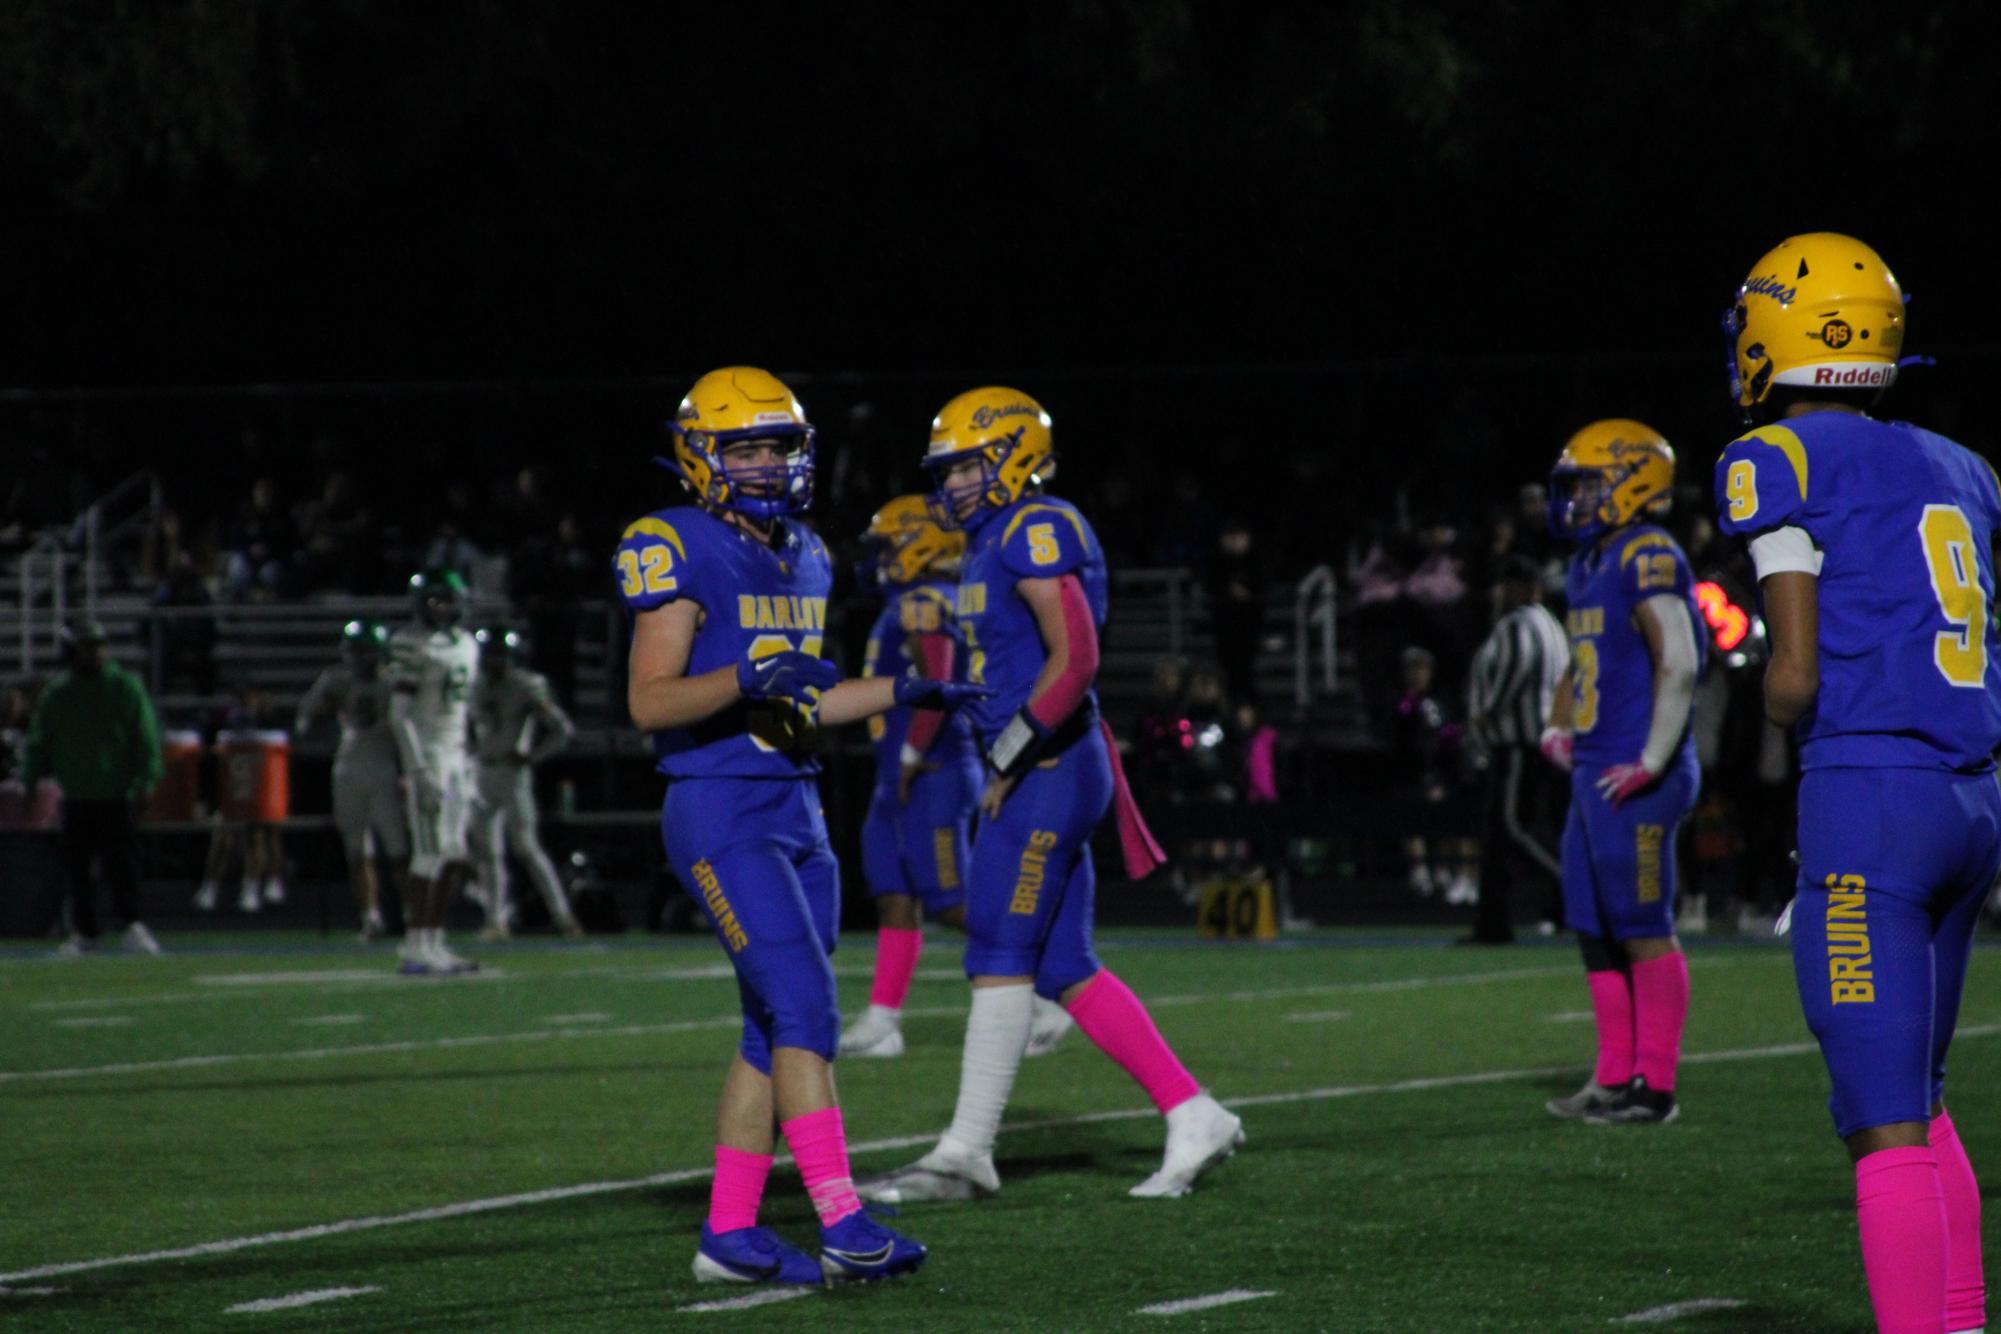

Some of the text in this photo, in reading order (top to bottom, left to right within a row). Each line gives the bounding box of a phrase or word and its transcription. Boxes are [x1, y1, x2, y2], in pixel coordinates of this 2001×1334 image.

[1815, 367, 1891, 384] Riddell
[1726, 459, 1759, 522] 9
[617, 544, 677, 597] 32
[1026, 522, 1060, 566] 5
[1918, 504, 1988, 689] 9
[1207, 891, 1258, 936] 40
[1825, 873, 1875, 1005] BRUINS
